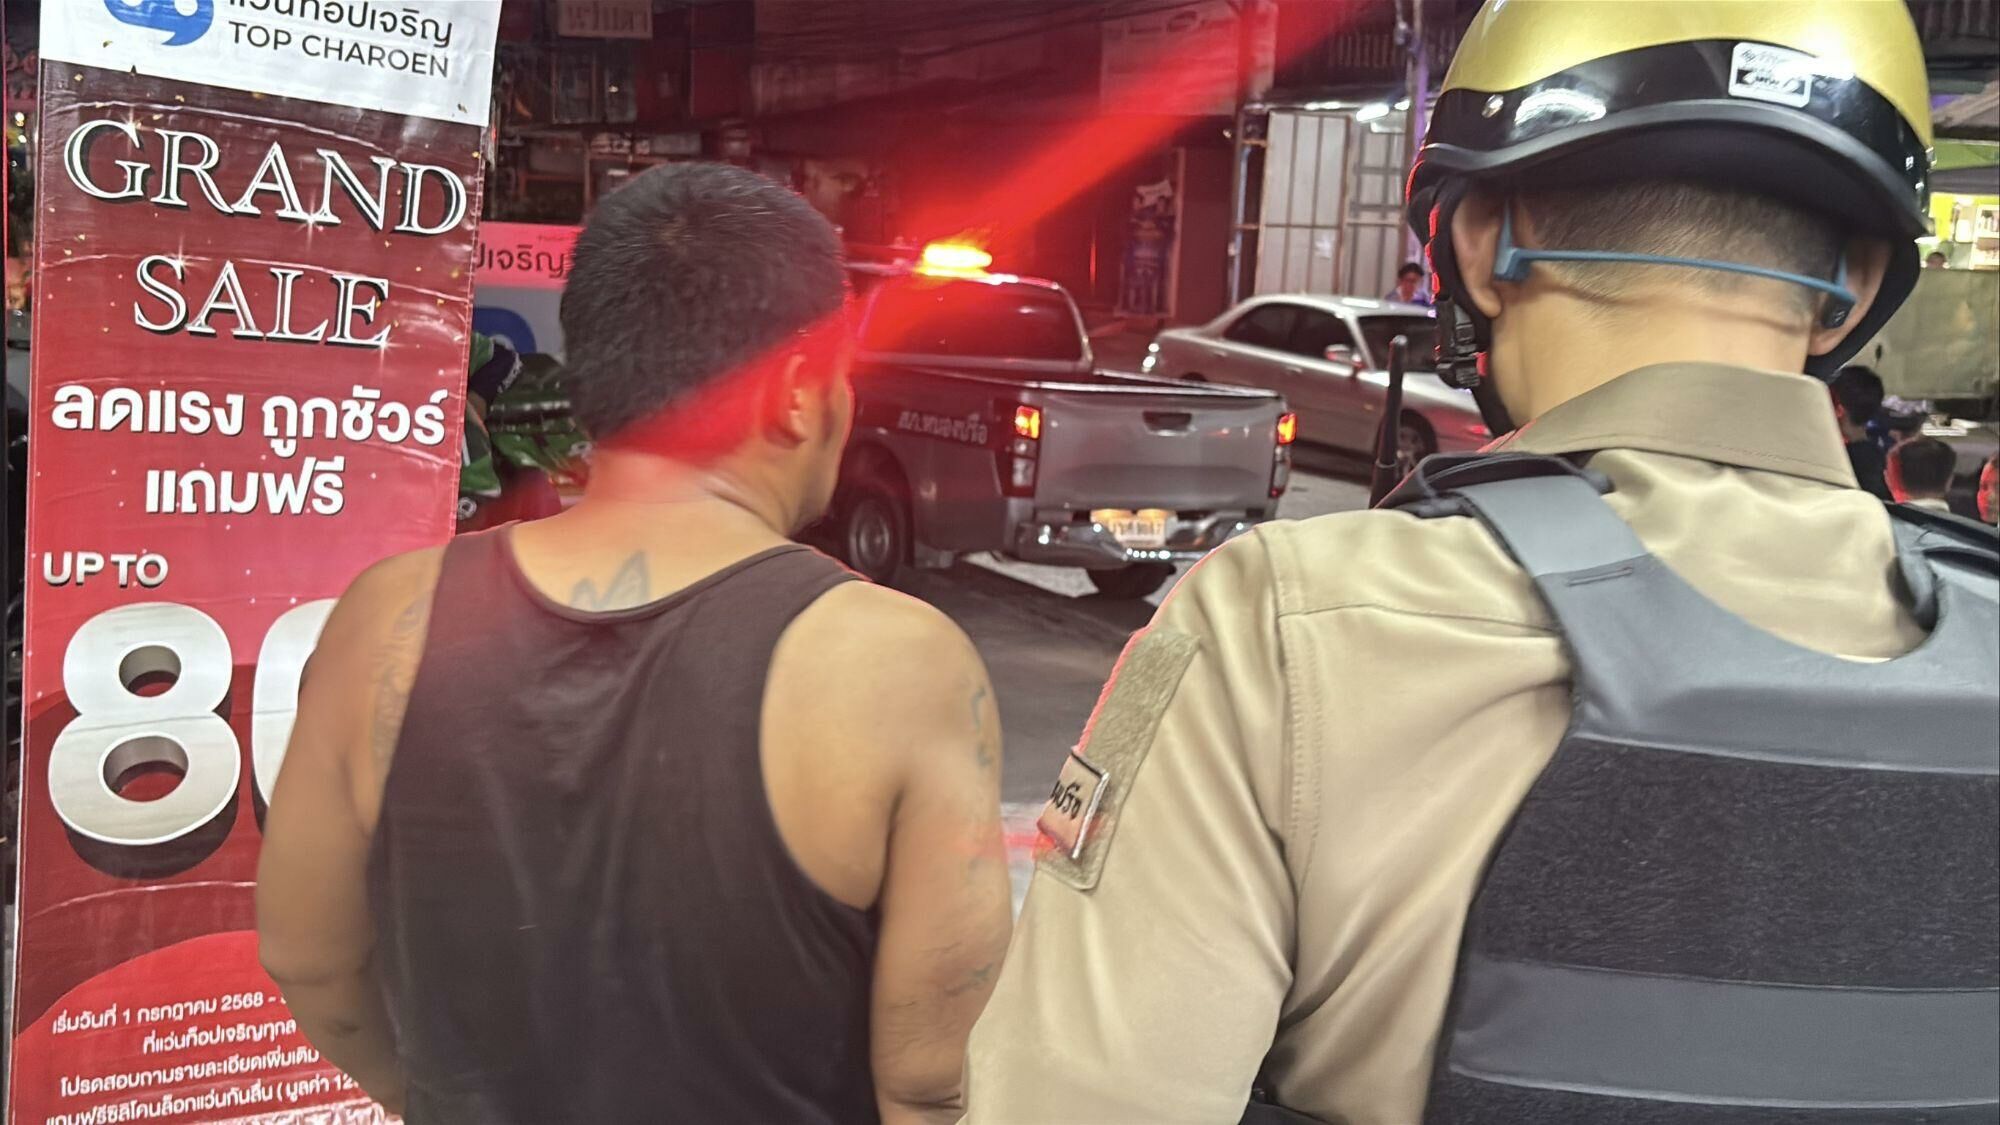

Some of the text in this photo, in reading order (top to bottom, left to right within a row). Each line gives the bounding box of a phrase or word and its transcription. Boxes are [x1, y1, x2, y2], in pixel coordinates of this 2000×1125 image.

[228, 20, 450, 79] TOP CHAROEN
[64, 119, 469, 237] GRAND
[134, 254, 393, 349] SALE
[51, 384, 449, 458] ลดแรง ถูกชัวร์
[145, 455, 346, 516] แถมฟรี
[43, 550, 170, 588] UP TO
[52, 1002, 117, 1035] เริ่มวันที่
[122, 1008, 131, 1025] 1
[137, 997, 218, 1024] กรกฎาคม
[220, 991, 264, 1013] 2568
[333, 1071, 360, 1091] 12
